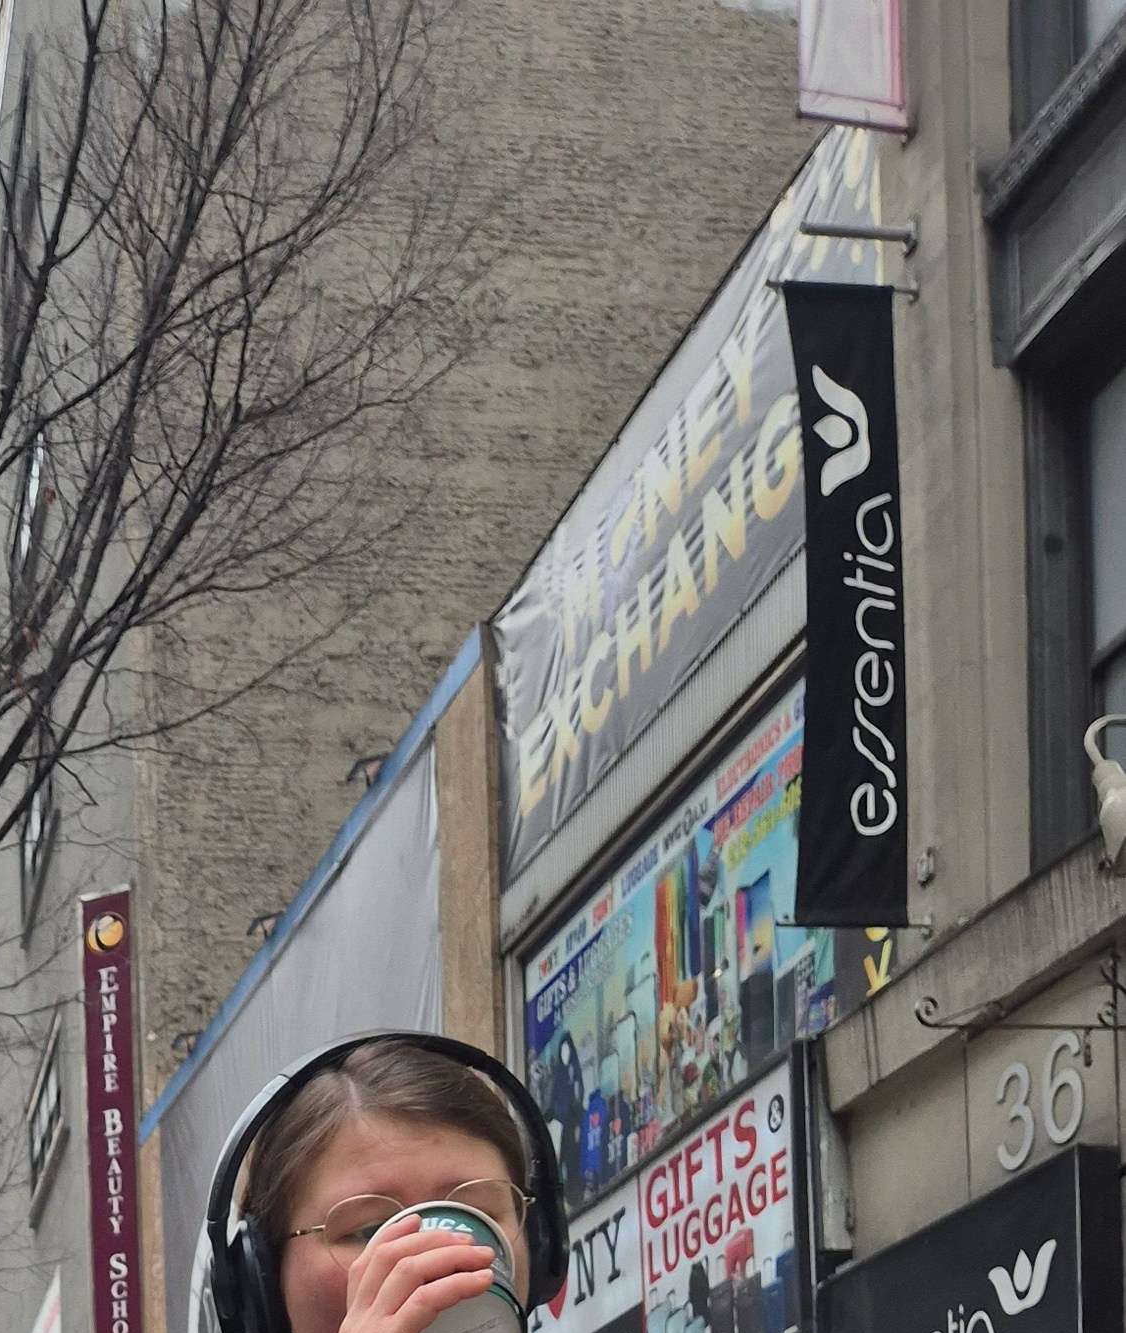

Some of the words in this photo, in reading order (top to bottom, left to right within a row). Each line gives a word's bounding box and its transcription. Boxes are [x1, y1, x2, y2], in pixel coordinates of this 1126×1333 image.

[519, 395, 803, 821] EXCHANG
[843, 491, 897, 837] essentia
[98, 966, 120, 1093] EMPIRE
[646, 1097, 758, 1230] GIFTS
[996, 1030, 1084, 1171] 36
[102, 1108, 123, 1235] BEAUTY
[647, 1148, 788, 1285] LUGGAGE
[571, 1206, 626, 1307] NY
